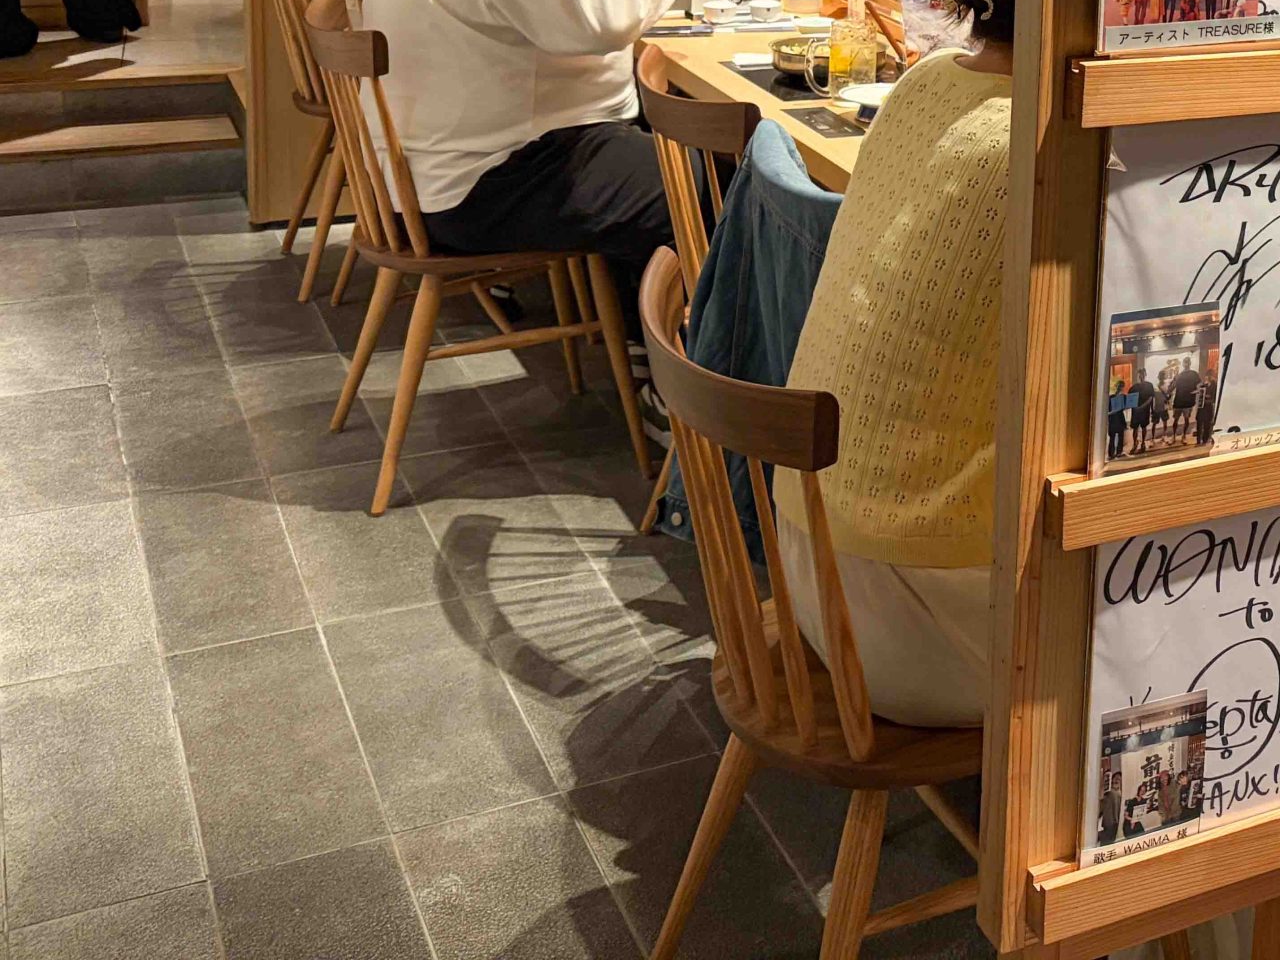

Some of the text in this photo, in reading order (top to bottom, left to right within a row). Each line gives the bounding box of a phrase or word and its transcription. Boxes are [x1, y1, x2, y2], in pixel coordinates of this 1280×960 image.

[1119, 21, 1275, 45] アーティスト TREASURE様
[1093, 849, 1117, 864] 歌手
[1123, 834, 1170, 855] WANIMA
